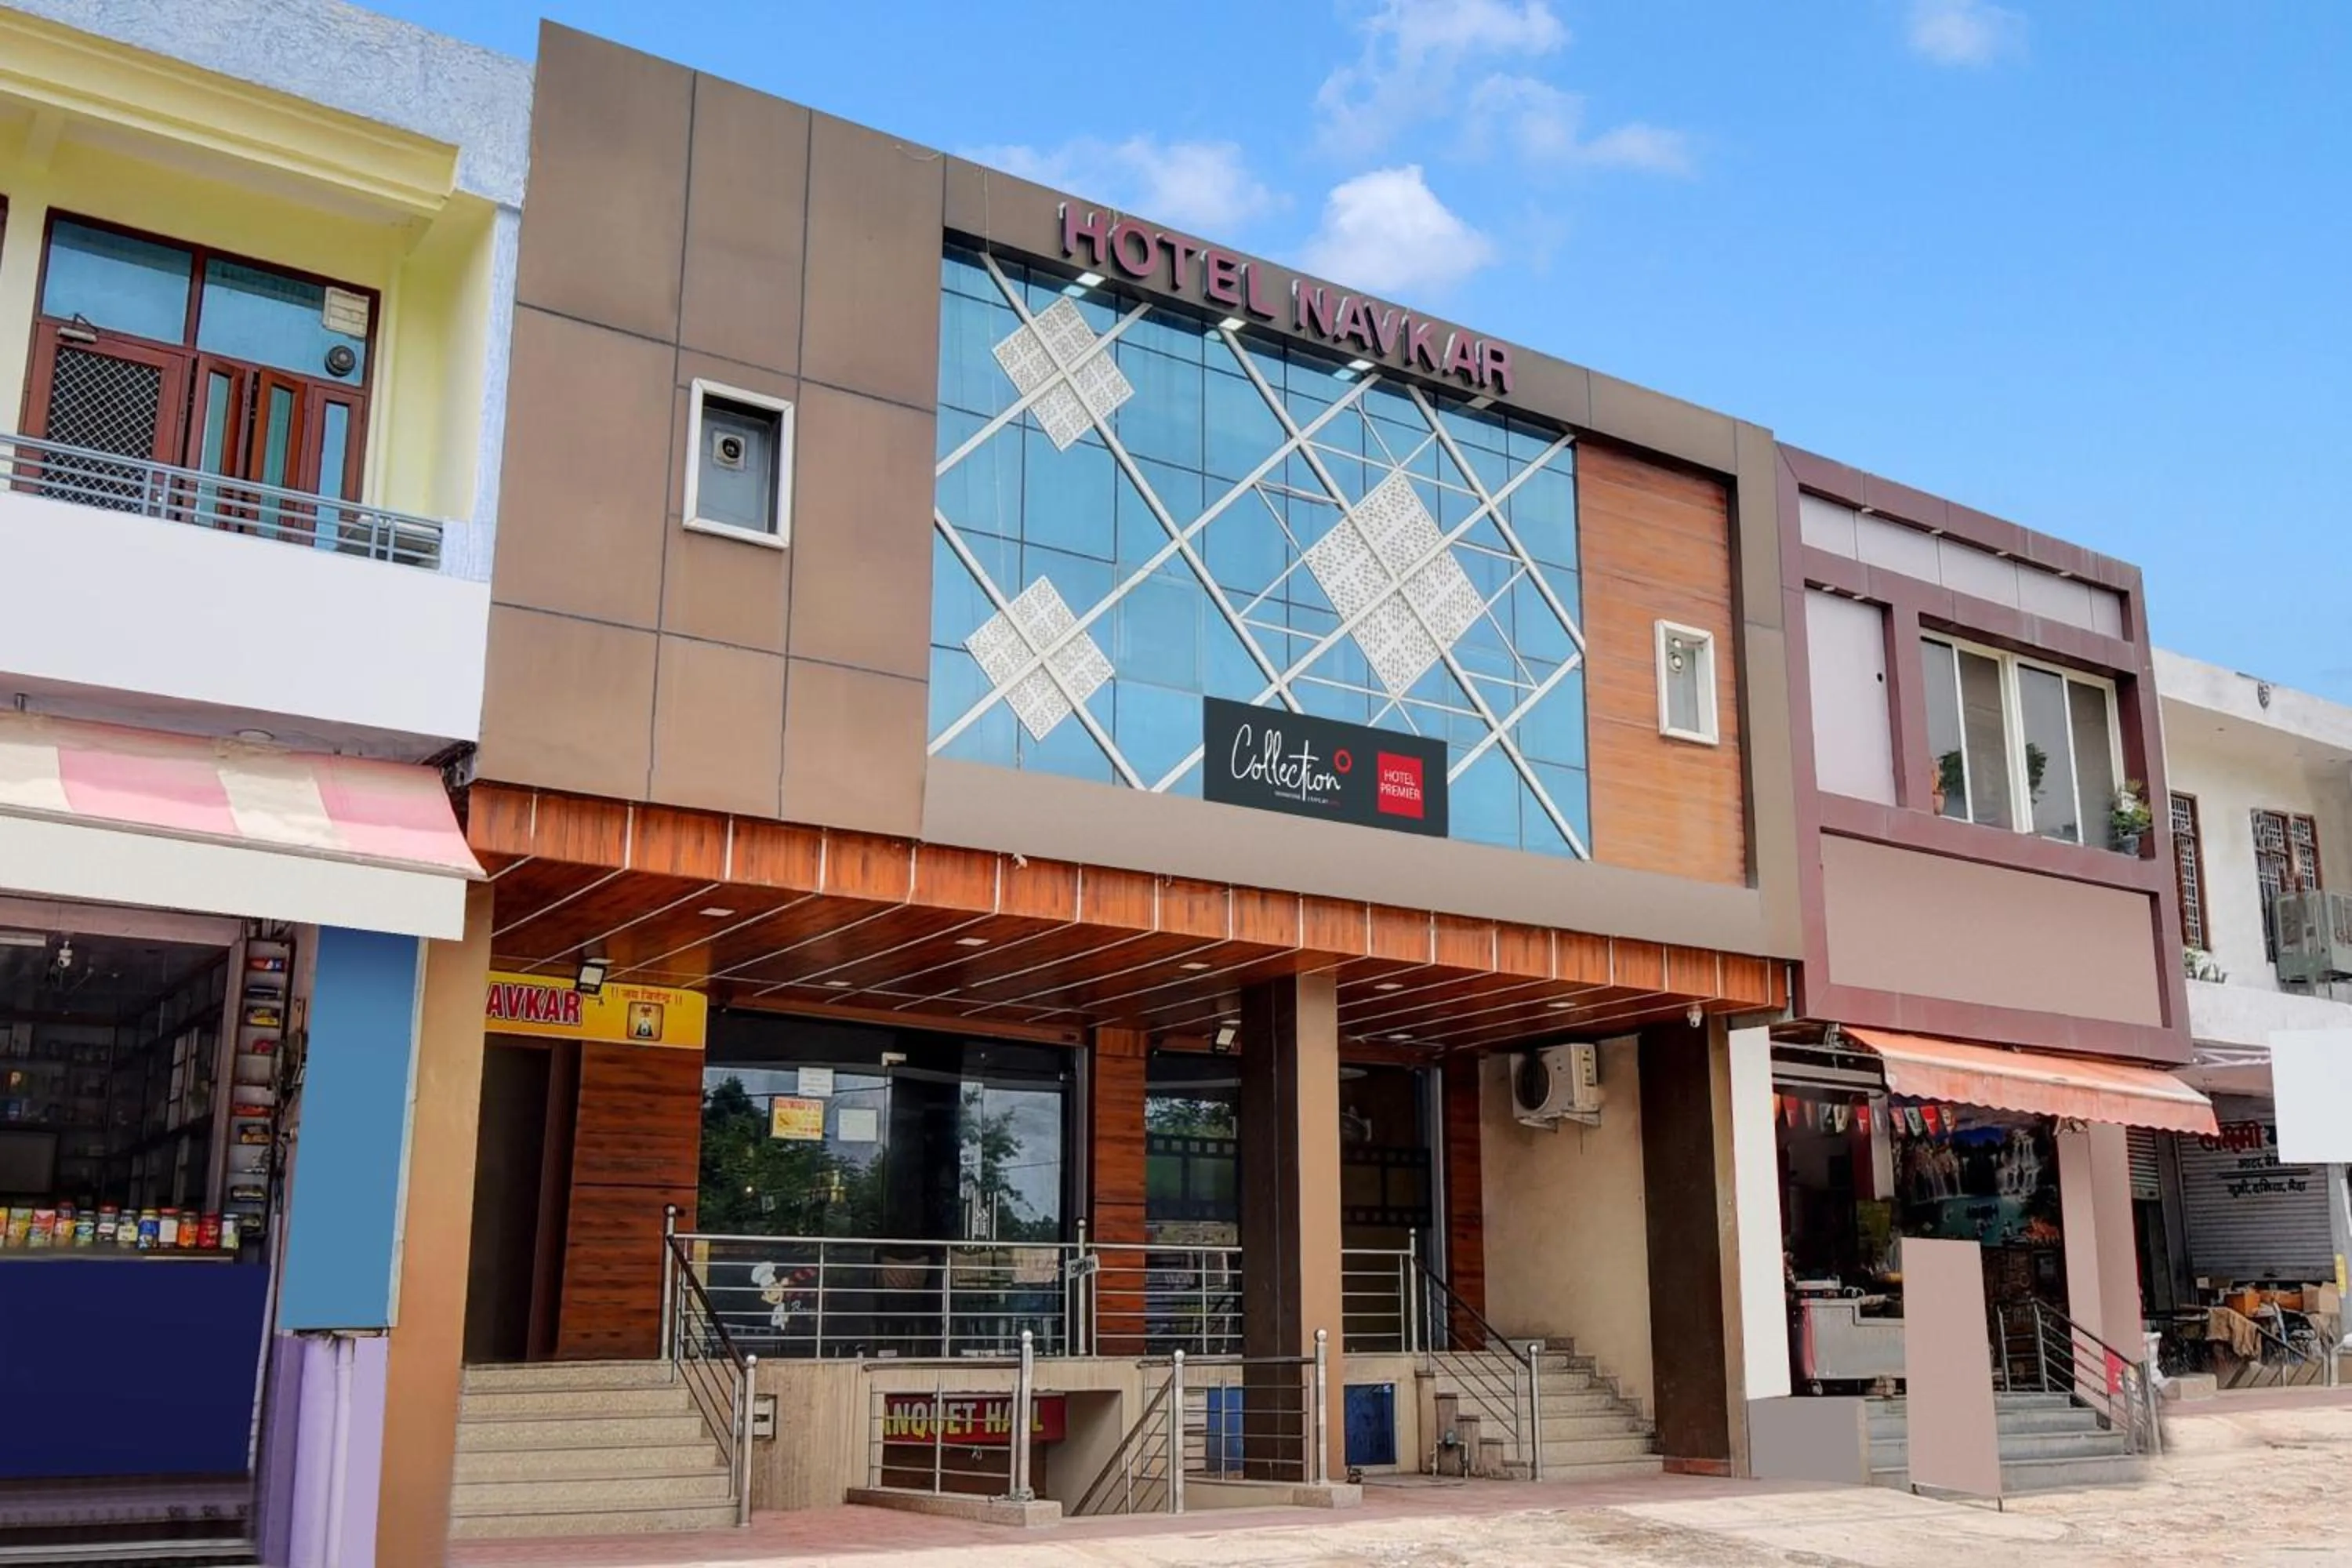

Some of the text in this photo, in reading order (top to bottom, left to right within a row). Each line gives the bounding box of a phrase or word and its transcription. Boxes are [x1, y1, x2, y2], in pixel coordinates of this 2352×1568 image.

[1060, 201, 1515, 393] HOTEL NAVKAR
[1232, 724, 1341, 800] Collection
[1384, 769, 1415, 786] HOTEL
[1380, 782, 1421, 800] PREMIER
[485, 982, 583, 1026] AVKAR
[884, 1400, 1044, 1439] NQUET HAL
